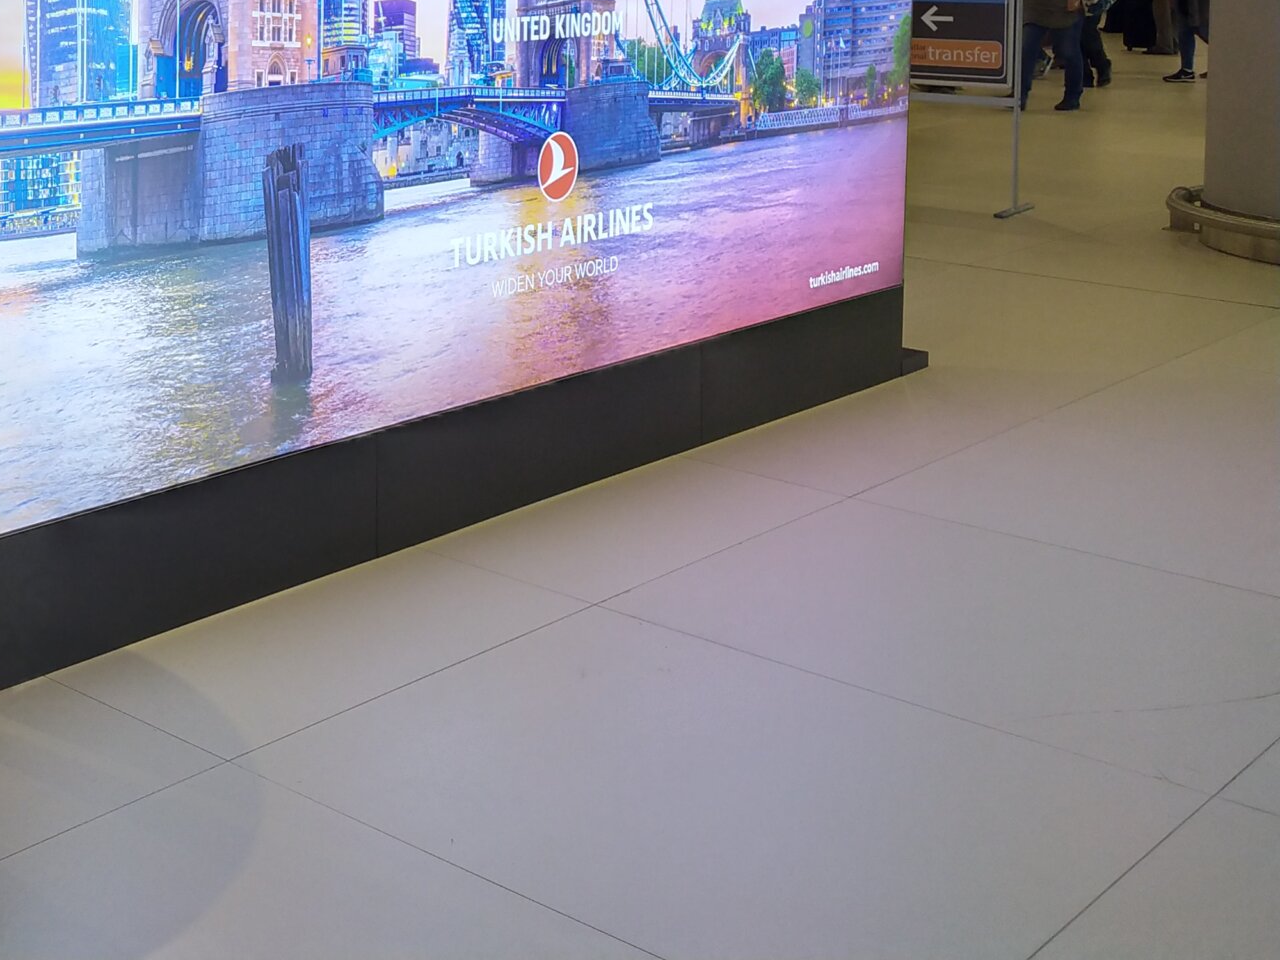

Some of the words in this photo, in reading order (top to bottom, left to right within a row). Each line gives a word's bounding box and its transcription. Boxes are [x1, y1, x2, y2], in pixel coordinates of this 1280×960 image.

[492, 15, 550, 43] UNITED
[555, 11, 624, 39] KINGDOM
[928, 46, 998, 63] transfer
[450, 224, 554, 268] TURKISH
[560, 202, 654, 248] AIRLINES
[492, 273, 534, 298] WIDEN
[537, 265, 573, 286] YOUR
[575, 255, 619, 279] WORLD
[809, 261, 879, 288] turkishairlines.com
